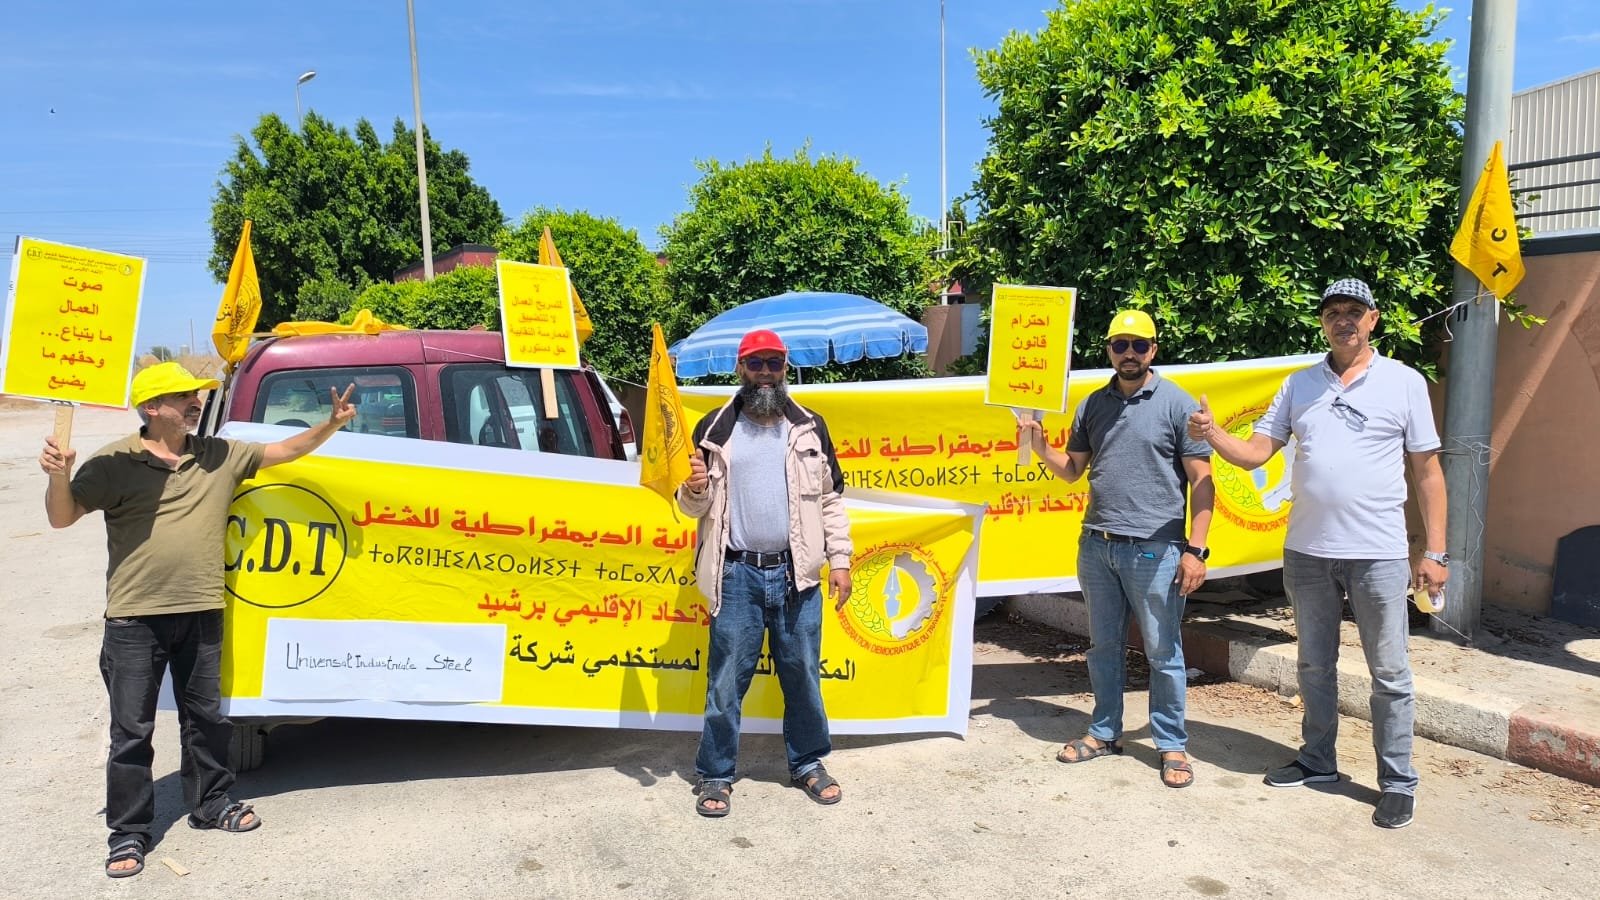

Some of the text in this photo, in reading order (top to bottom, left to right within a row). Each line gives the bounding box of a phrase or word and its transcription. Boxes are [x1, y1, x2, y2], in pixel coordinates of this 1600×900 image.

[63, 276, 103, 292] صوت
[59, 300, 99, 315] العمال
[1011, 314, 1050, 328] احترام
[99, 329, 113, 342] ما
[1011, 334, 1047, 350] قانون
[42, 347, 105, 368] وحقهم ما
[1011, 357, 1047, 370] الشغل
[48, 375, 86, 390] يضيع
[1008, 380, 1043, 394] واجب
[880, 428, 1020, 462] لديمقراطية
[352, 501, 439, 528] للشغل
[451, 511, 642, 548] الديمقراطية
[224, 515, 337, 576] C.D.T
[477, 588, 711, 627] لاتحاد الإقليمي برشيد
[425, 653, 472, 672] Steel
[509, 634, 856, 681] المك لمستخدمي شركة
